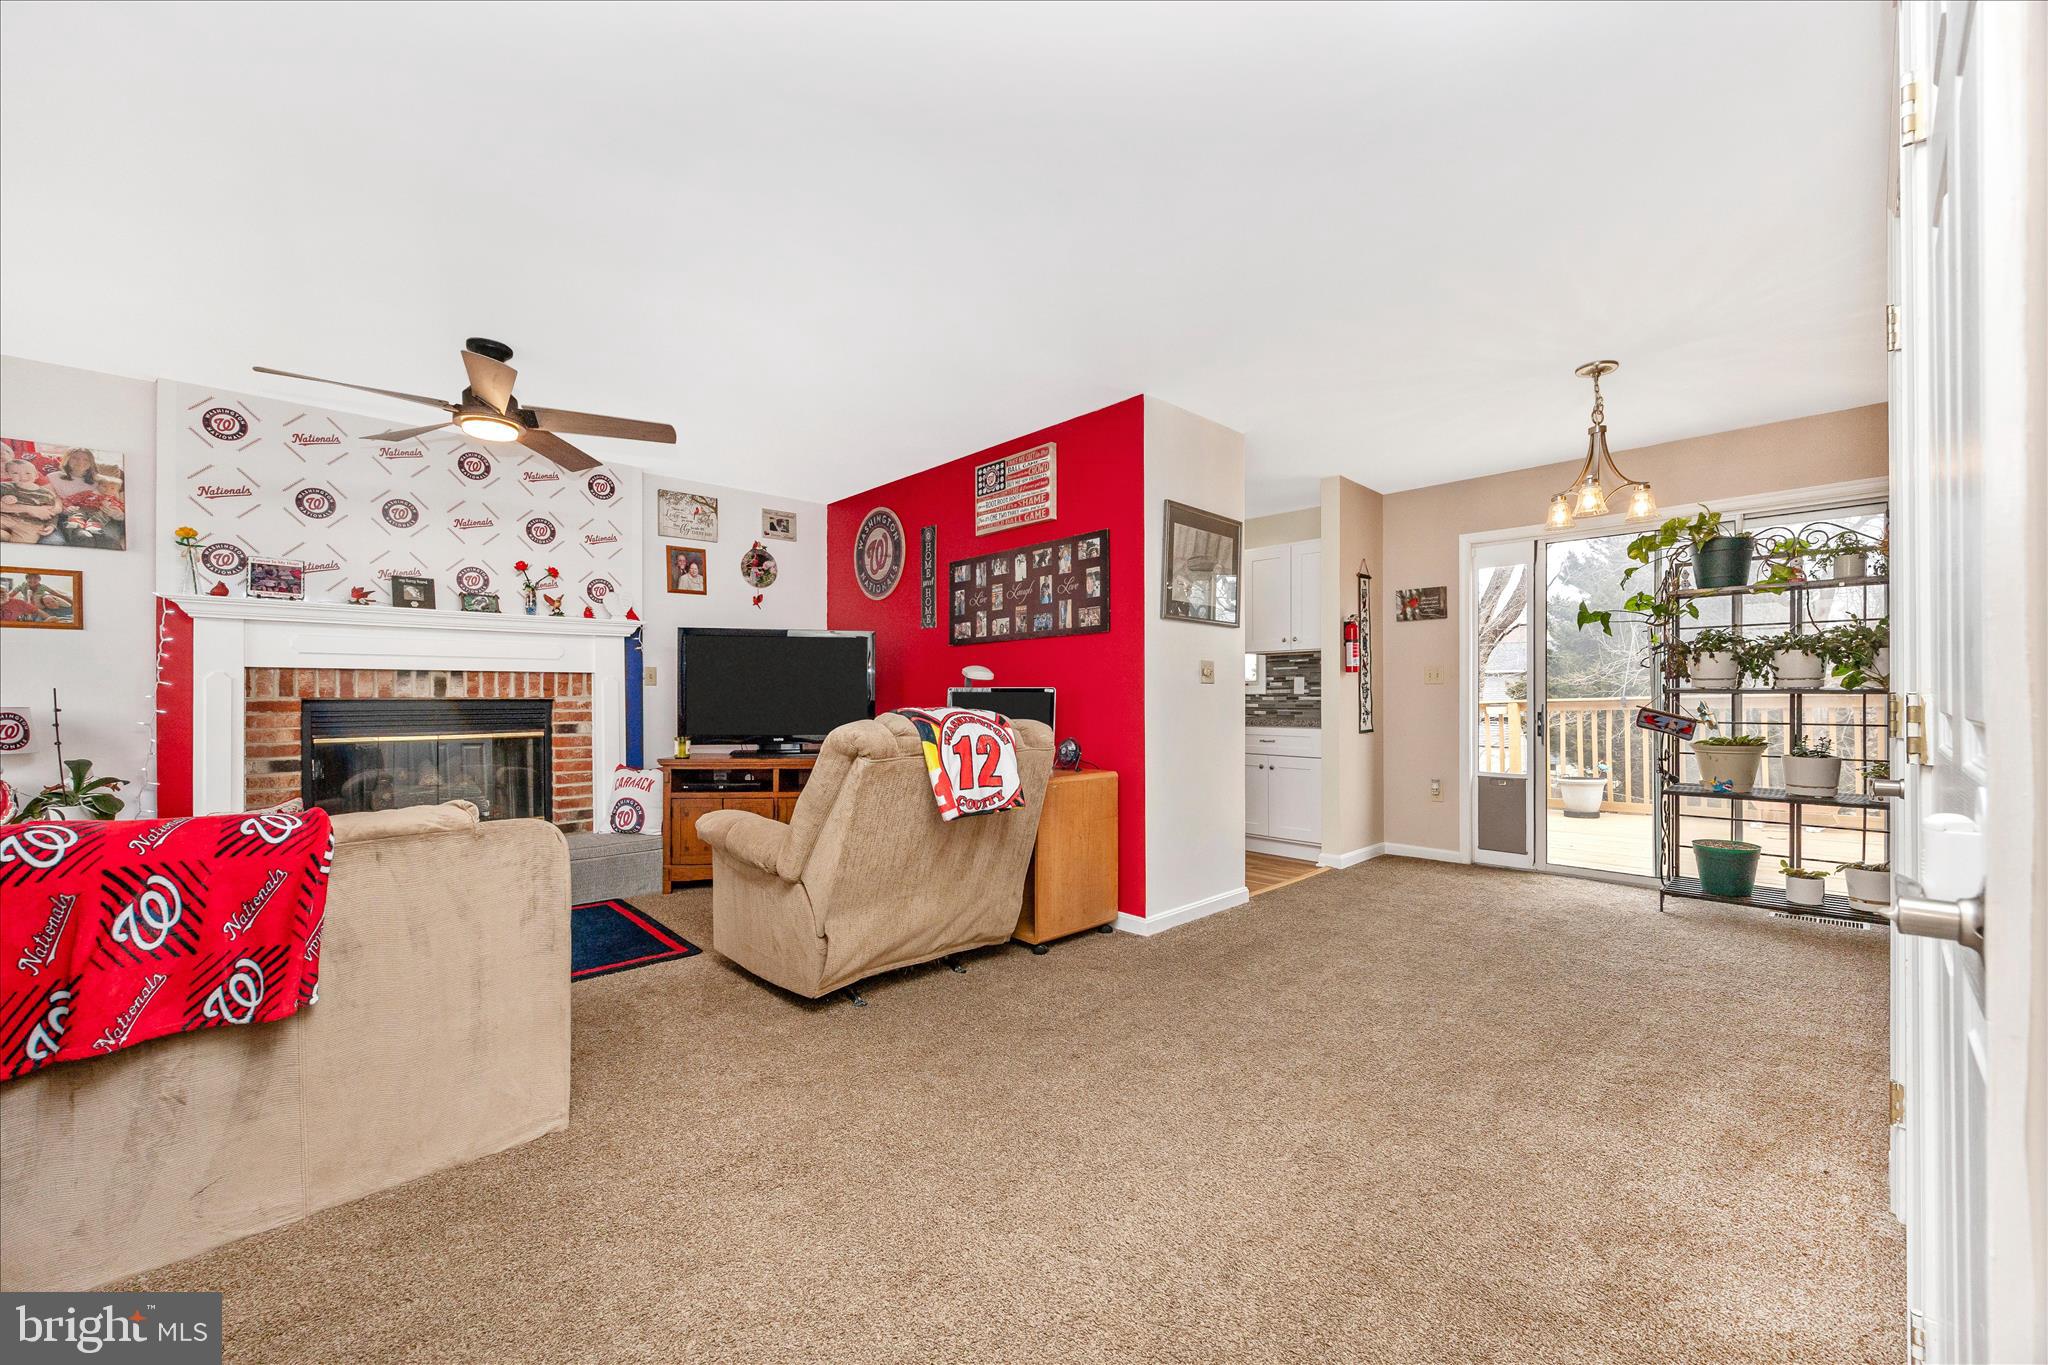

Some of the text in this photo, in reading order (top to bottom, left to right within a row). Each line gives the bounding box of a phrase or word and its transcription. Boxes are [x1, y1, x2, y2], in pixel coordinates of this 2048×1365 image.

[205, 409, 246, 425] WASHINGTON
[207, 426, 244, 440] NATIONALS
[291, 433, 341, 446] Nationals
[379, 447, 424, 459] Nationals
[1028, 461, 1049, 475] CROWD
[523, 471, 560, 482] Nationals
[197, 485, 253, 499] Nationals
[1018, 492, 1047, 507] SHAME
[1024, 508, 1047, 521] GAME
[453, 517, 494, 529] Nationals
[858, 513, 899, 550] WASHINGTON
[584, 533, 618, 545] Nationals
[204, 544, 245, 558] WASHINGTON
[303, 560, 341, 574] ationals
[924, 542, 932, 578] HOME
[206, 562, 243, 575] NATIONALS
[377, 568, 422, 581] Nationals
[861, 564, 899, 593] NATIONALS
[1006, 579, 1035, 604] Laugh
[1057, 576, 1079, 594] Love
[924, 588, 932, 623] HOME
[952, 734, 1003, 790] 12
[612, 799, 643, 815] WASHINGTON
[223, 867, 289, 941] Nationals
[17, 892, 77, 976] Nationals
[92, 972, 168, 1053] Nationals
